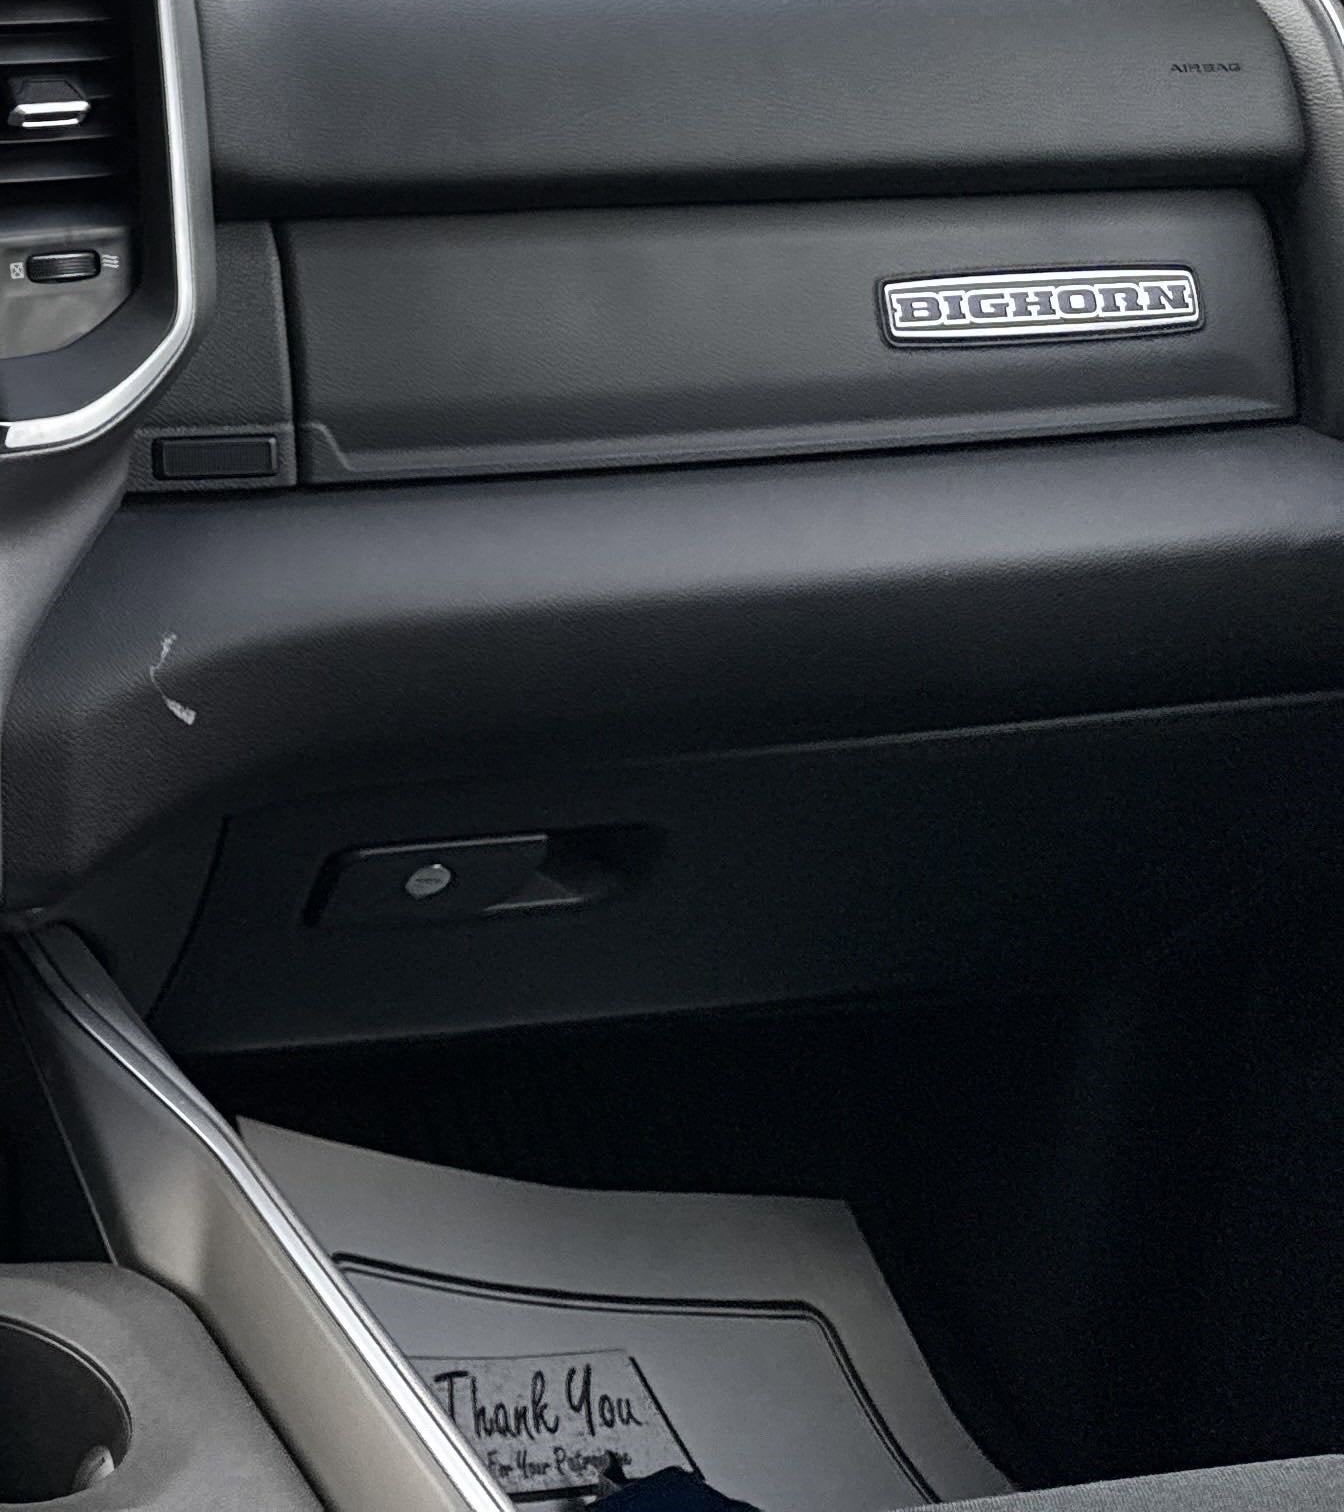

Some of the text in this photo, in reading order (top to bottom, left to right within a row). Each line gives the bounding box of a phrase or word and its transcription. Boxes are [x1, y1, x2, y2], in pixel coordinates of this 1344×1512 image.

[1170, 62, 1241, 73] AIRBAG
[890, 281, 1194, 328] BIGHORN
[434, 1363, 643, 1440] Thank You
[487, 1451, 512, 1478] For
[516, 1450, 550, 1478] Your
